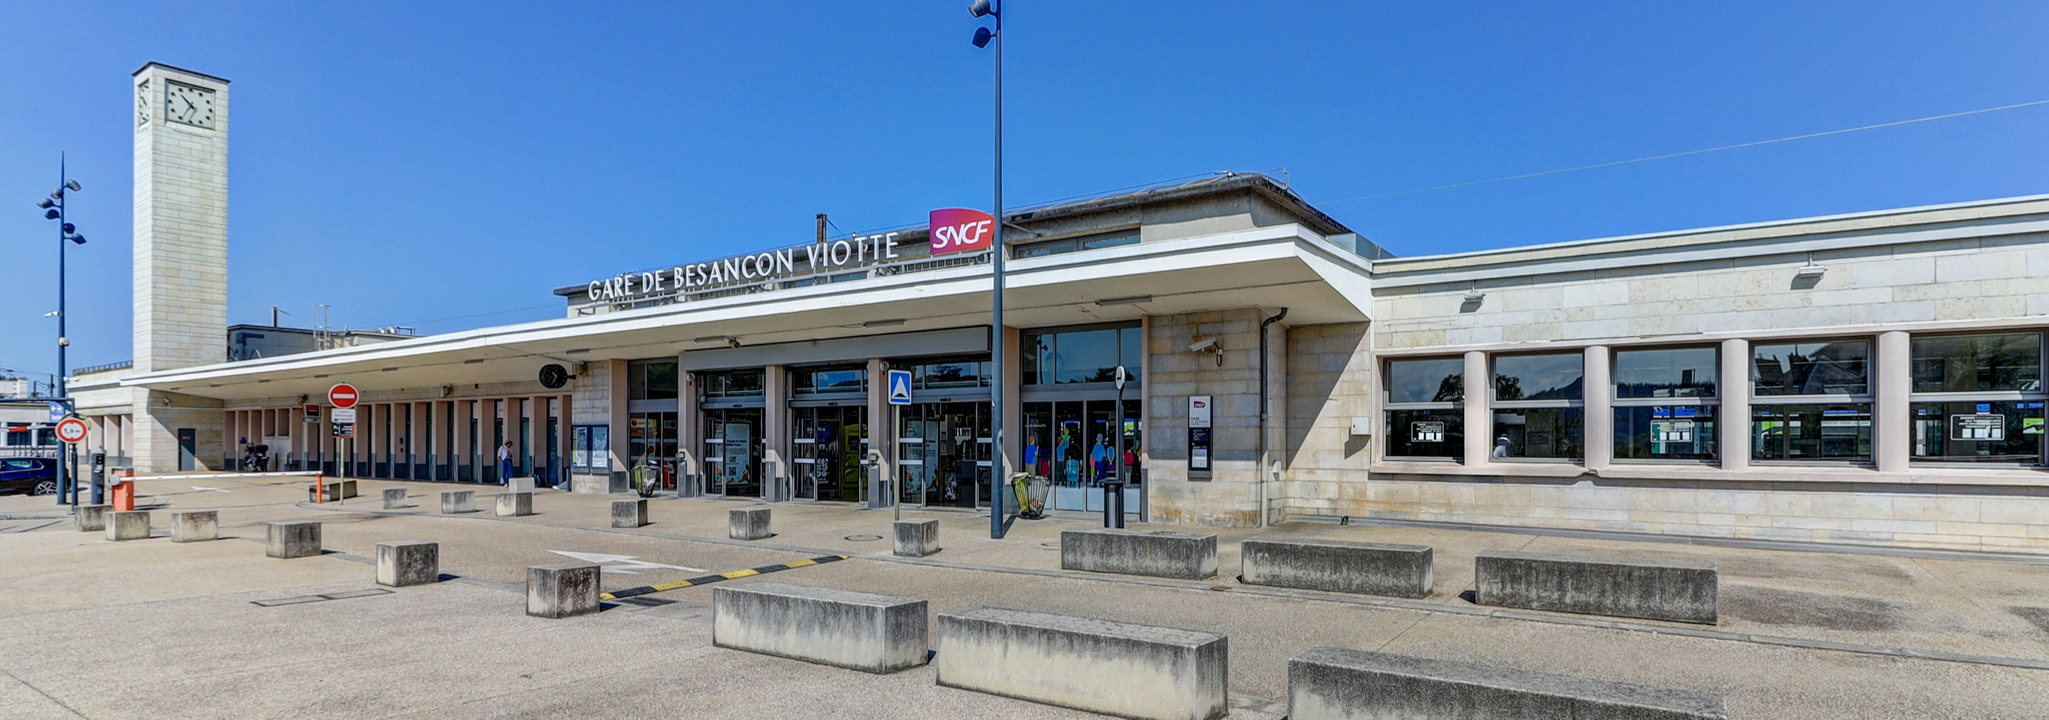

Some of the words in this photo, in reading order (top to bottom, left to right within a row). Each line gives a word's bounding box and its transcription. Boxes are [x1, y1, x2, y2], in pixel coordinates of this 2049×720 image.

[932, 219, 992, 249] SNCF
[588, 274, 634, 302] GARE
[642, 269, 665, 294] DE
[806, 232, 899, 270] VIOTTE
